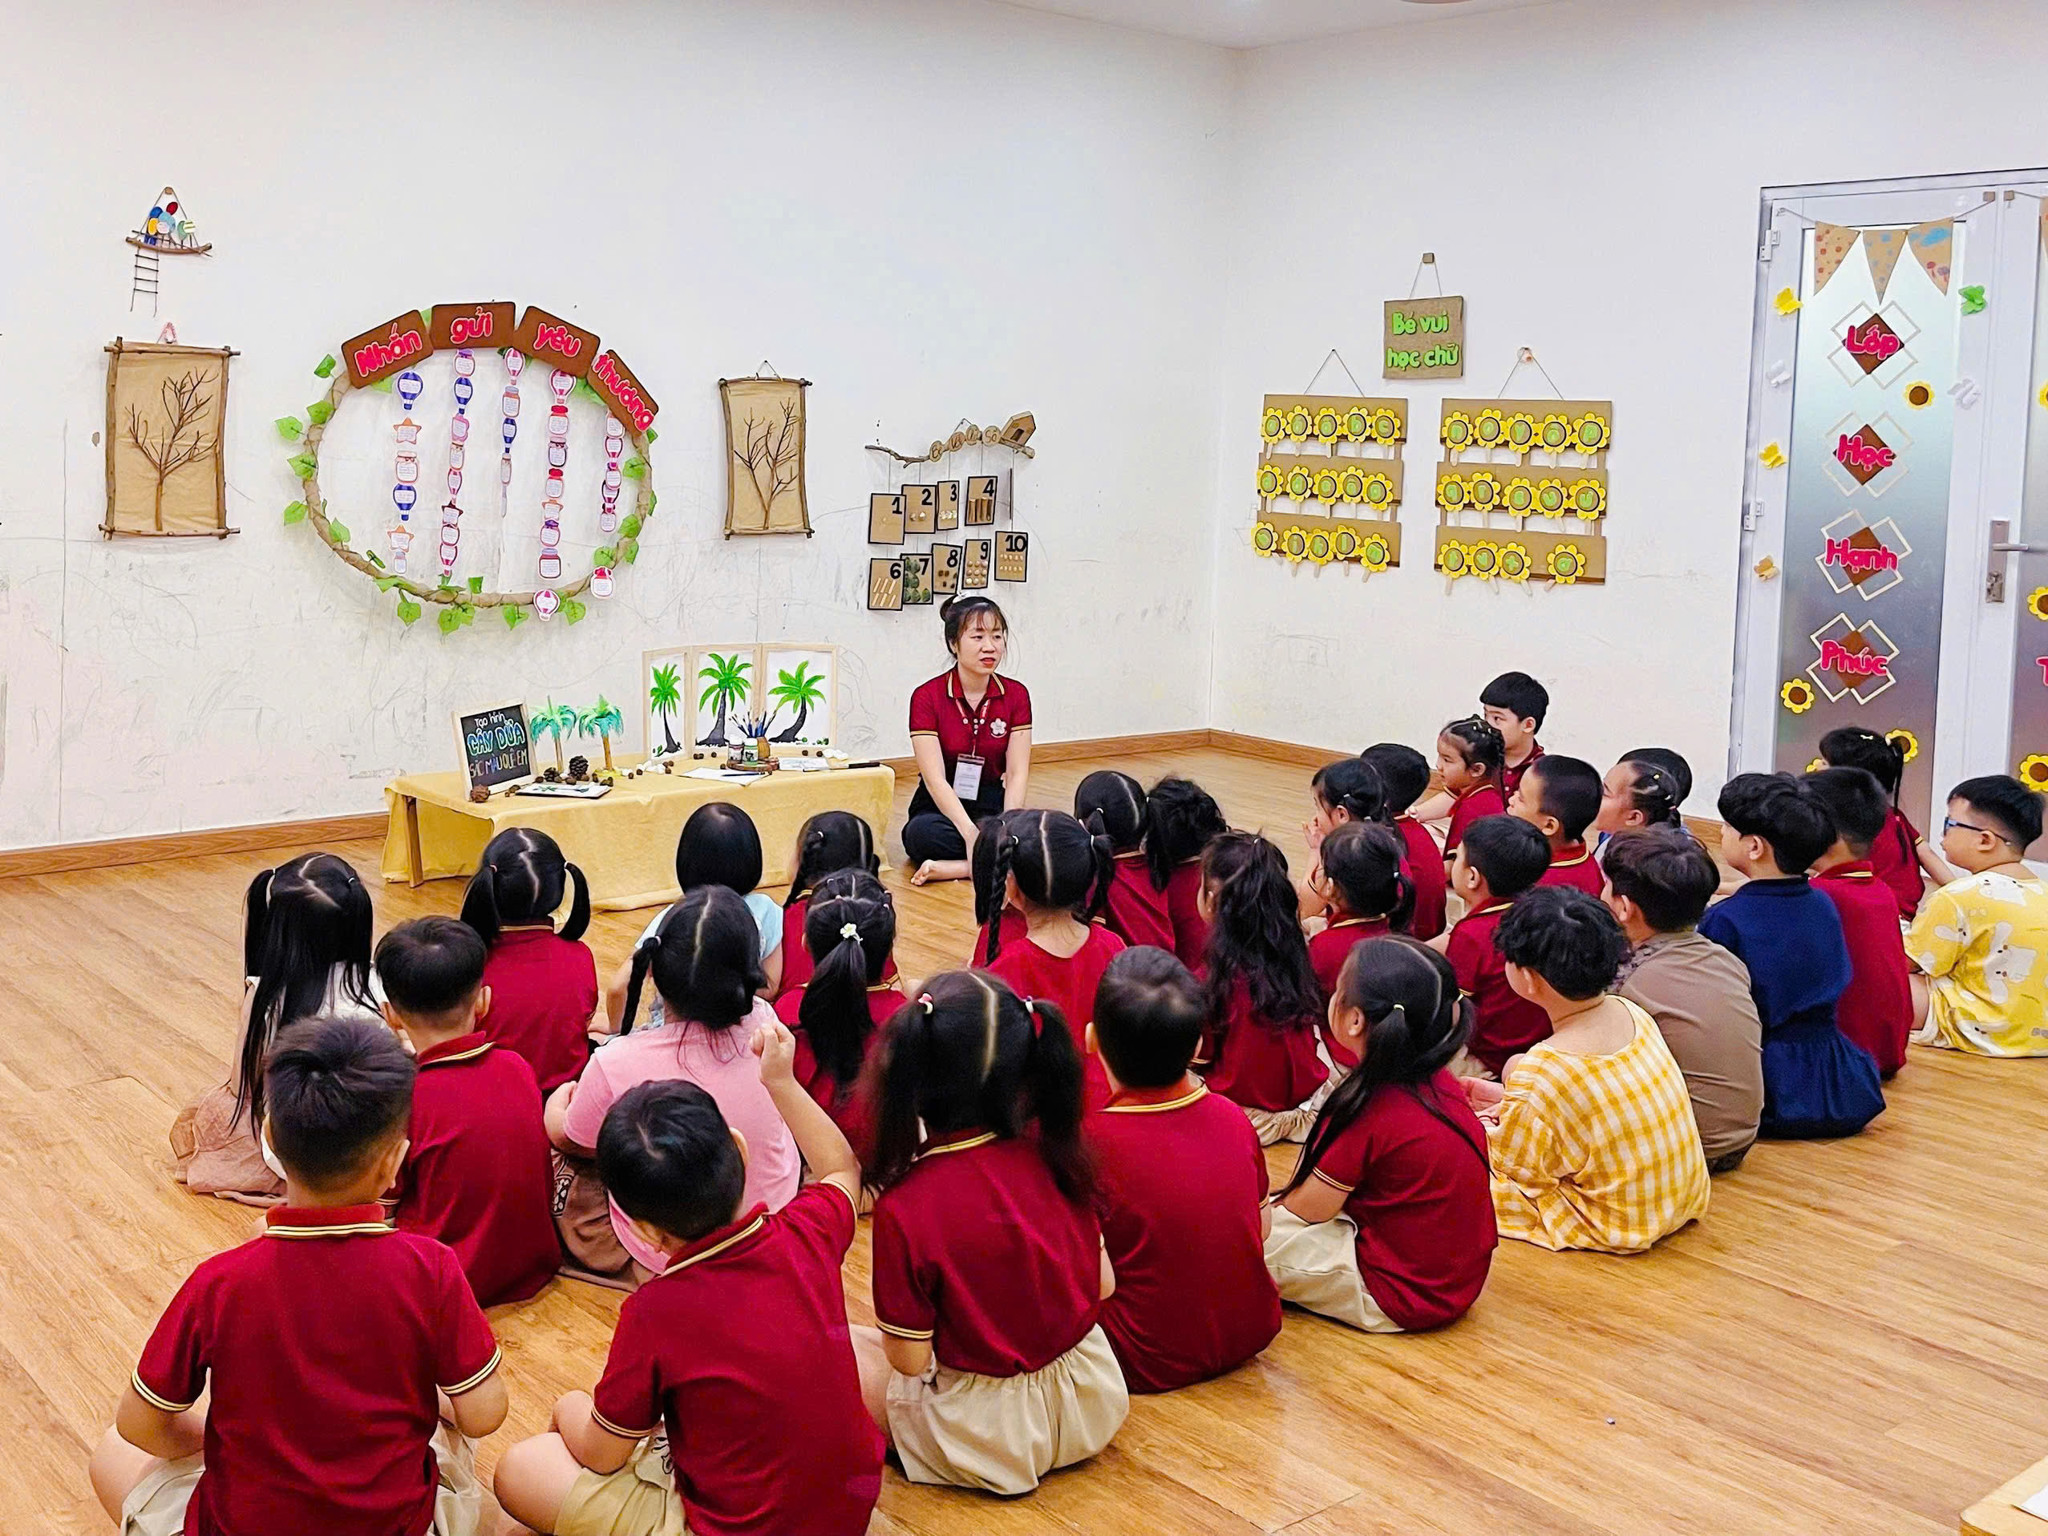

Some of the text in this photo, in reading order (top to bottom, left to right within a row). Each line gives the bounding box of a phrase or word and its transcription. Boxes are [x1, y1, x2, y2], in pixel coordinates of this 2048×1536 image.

[1392, 310, 1449, 335] Bé vui
[354, 322, 423, 378] Nhắn
[450, 305, 493, 345] gửi
[533, 322, 582, 358] yêu
[1386, 342, 1460, 372] học chữ
[1845, 324, 1900, 360] Lớp
[1836, 433, 1894, 472] Học
[891, 479, 995, 515] 1 2 3 4
[890, 541, 989, 579] 6 7 8 9
[1005, 535, 1028, 552] 10
[1824, 537, 1899, 574] Hạnh
[1820, 639, 1890, 676] Phúc
[467, 718, 526, 756] CÂY DỪA
[517, 748, 528, 766] EM
